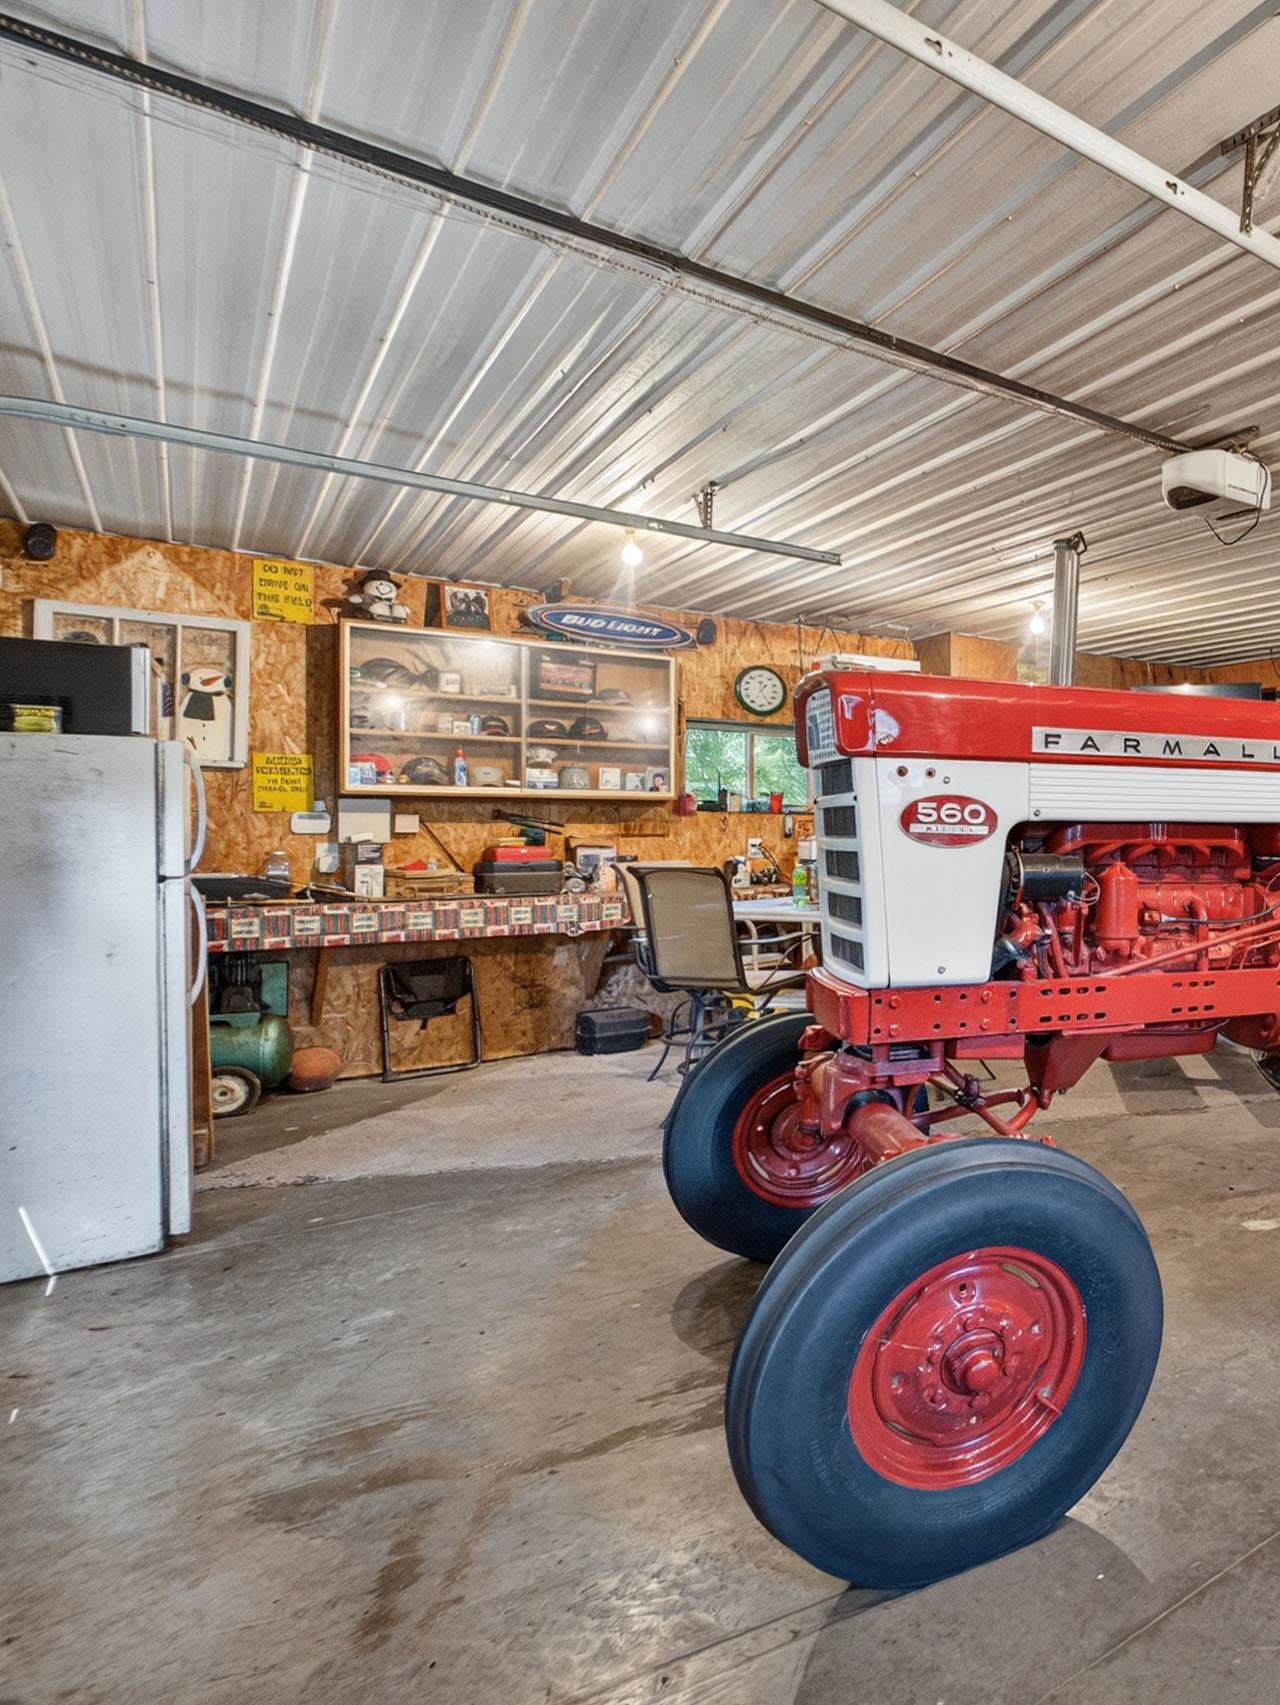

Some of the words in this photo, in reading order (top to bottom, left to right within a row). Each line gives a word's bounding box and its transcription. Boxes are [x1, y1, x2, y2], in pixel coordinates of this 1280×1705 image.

[561, 614, 606, 629] BUD
[606, 620, 663, 636] LIGHT
[916, 802, 987, 825] 560
